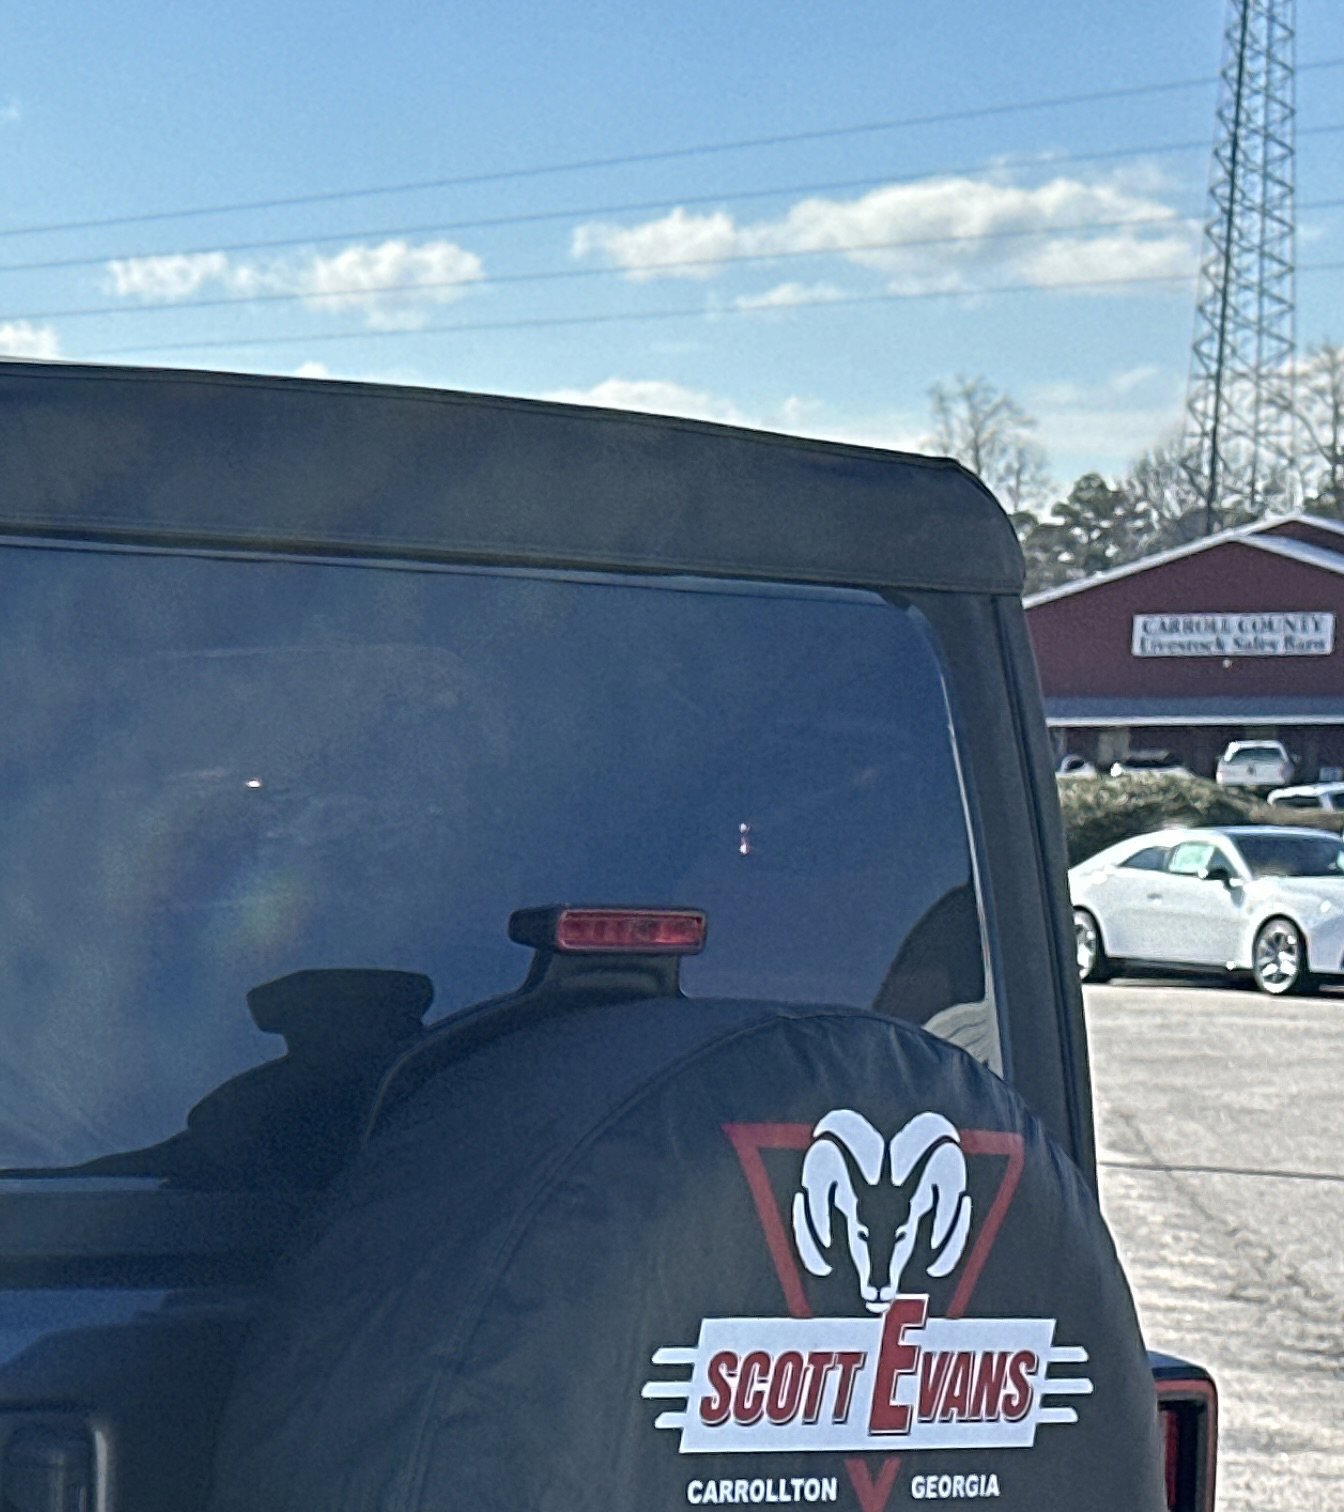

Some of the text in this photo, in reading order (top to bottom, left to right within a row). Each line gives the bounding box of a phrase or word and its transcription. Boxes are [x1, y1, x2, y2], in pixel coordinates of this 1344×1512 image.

[1142, 615, 1323, 634] CARROLL COUNTY
[699, 1294, 1039, 1437] SCOTT EVANS
[687, 1473, 1001, 1505] CARROLLTON GEORGIA
